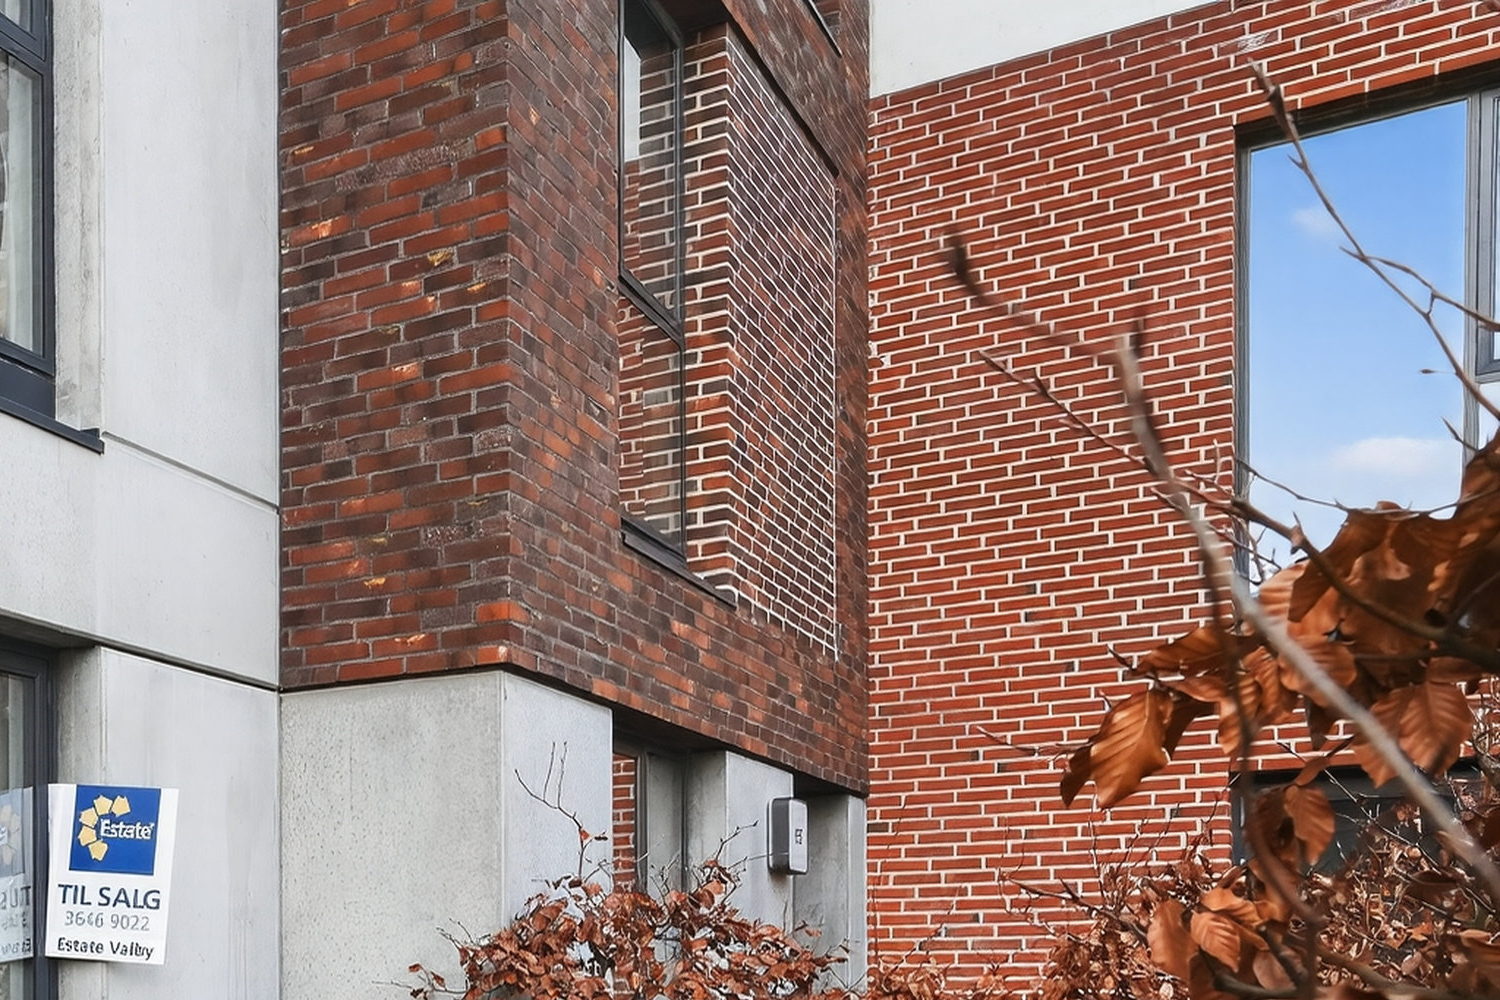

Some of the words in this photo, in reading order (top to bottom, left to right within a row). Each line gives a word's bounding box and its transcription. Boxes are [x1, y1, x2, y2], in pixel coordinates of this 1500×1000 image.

[100, 820, 153, 840] Estate
[58, 884, 91, 905] TIL
[98, 887, 160, 910] SALG
[110, 914, 150, 931] 9022
[57, 937, 104, 954] Estate
